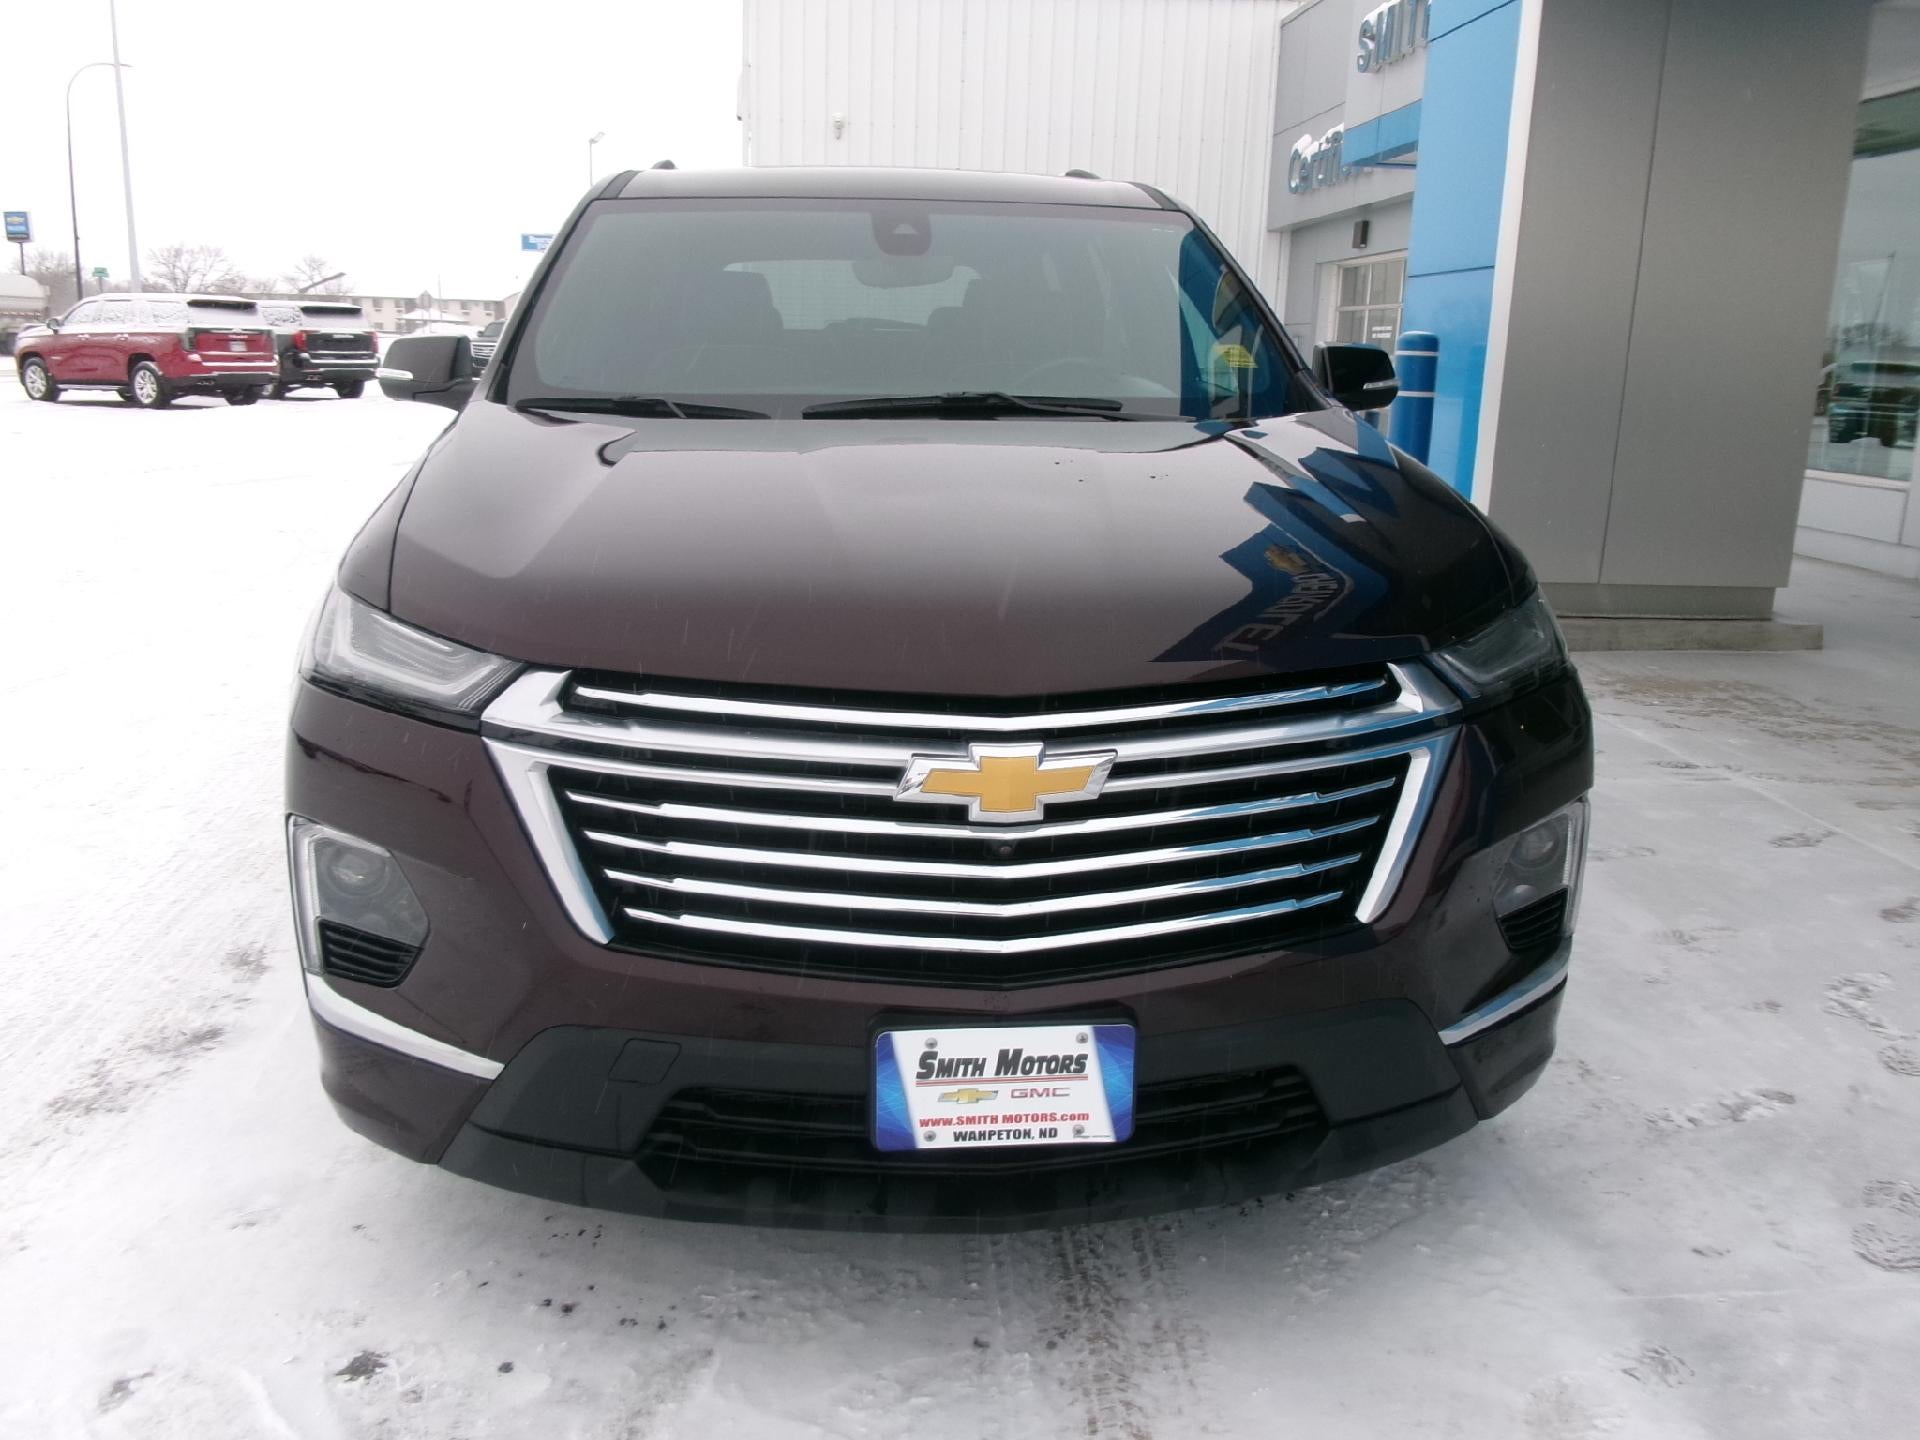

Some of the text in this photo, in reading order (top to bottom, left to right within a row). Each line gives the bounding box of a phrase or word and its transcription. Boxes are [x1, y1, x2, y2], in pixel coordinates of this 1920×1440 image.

[916, 1048, 1088, 1080] SMITH MOTORS
[1010, 1087, 1071, 1099] GMC
[953, 1129, 1035, 1142] WAHPETON,
[1039, 1127, 1058, 1139] ND
